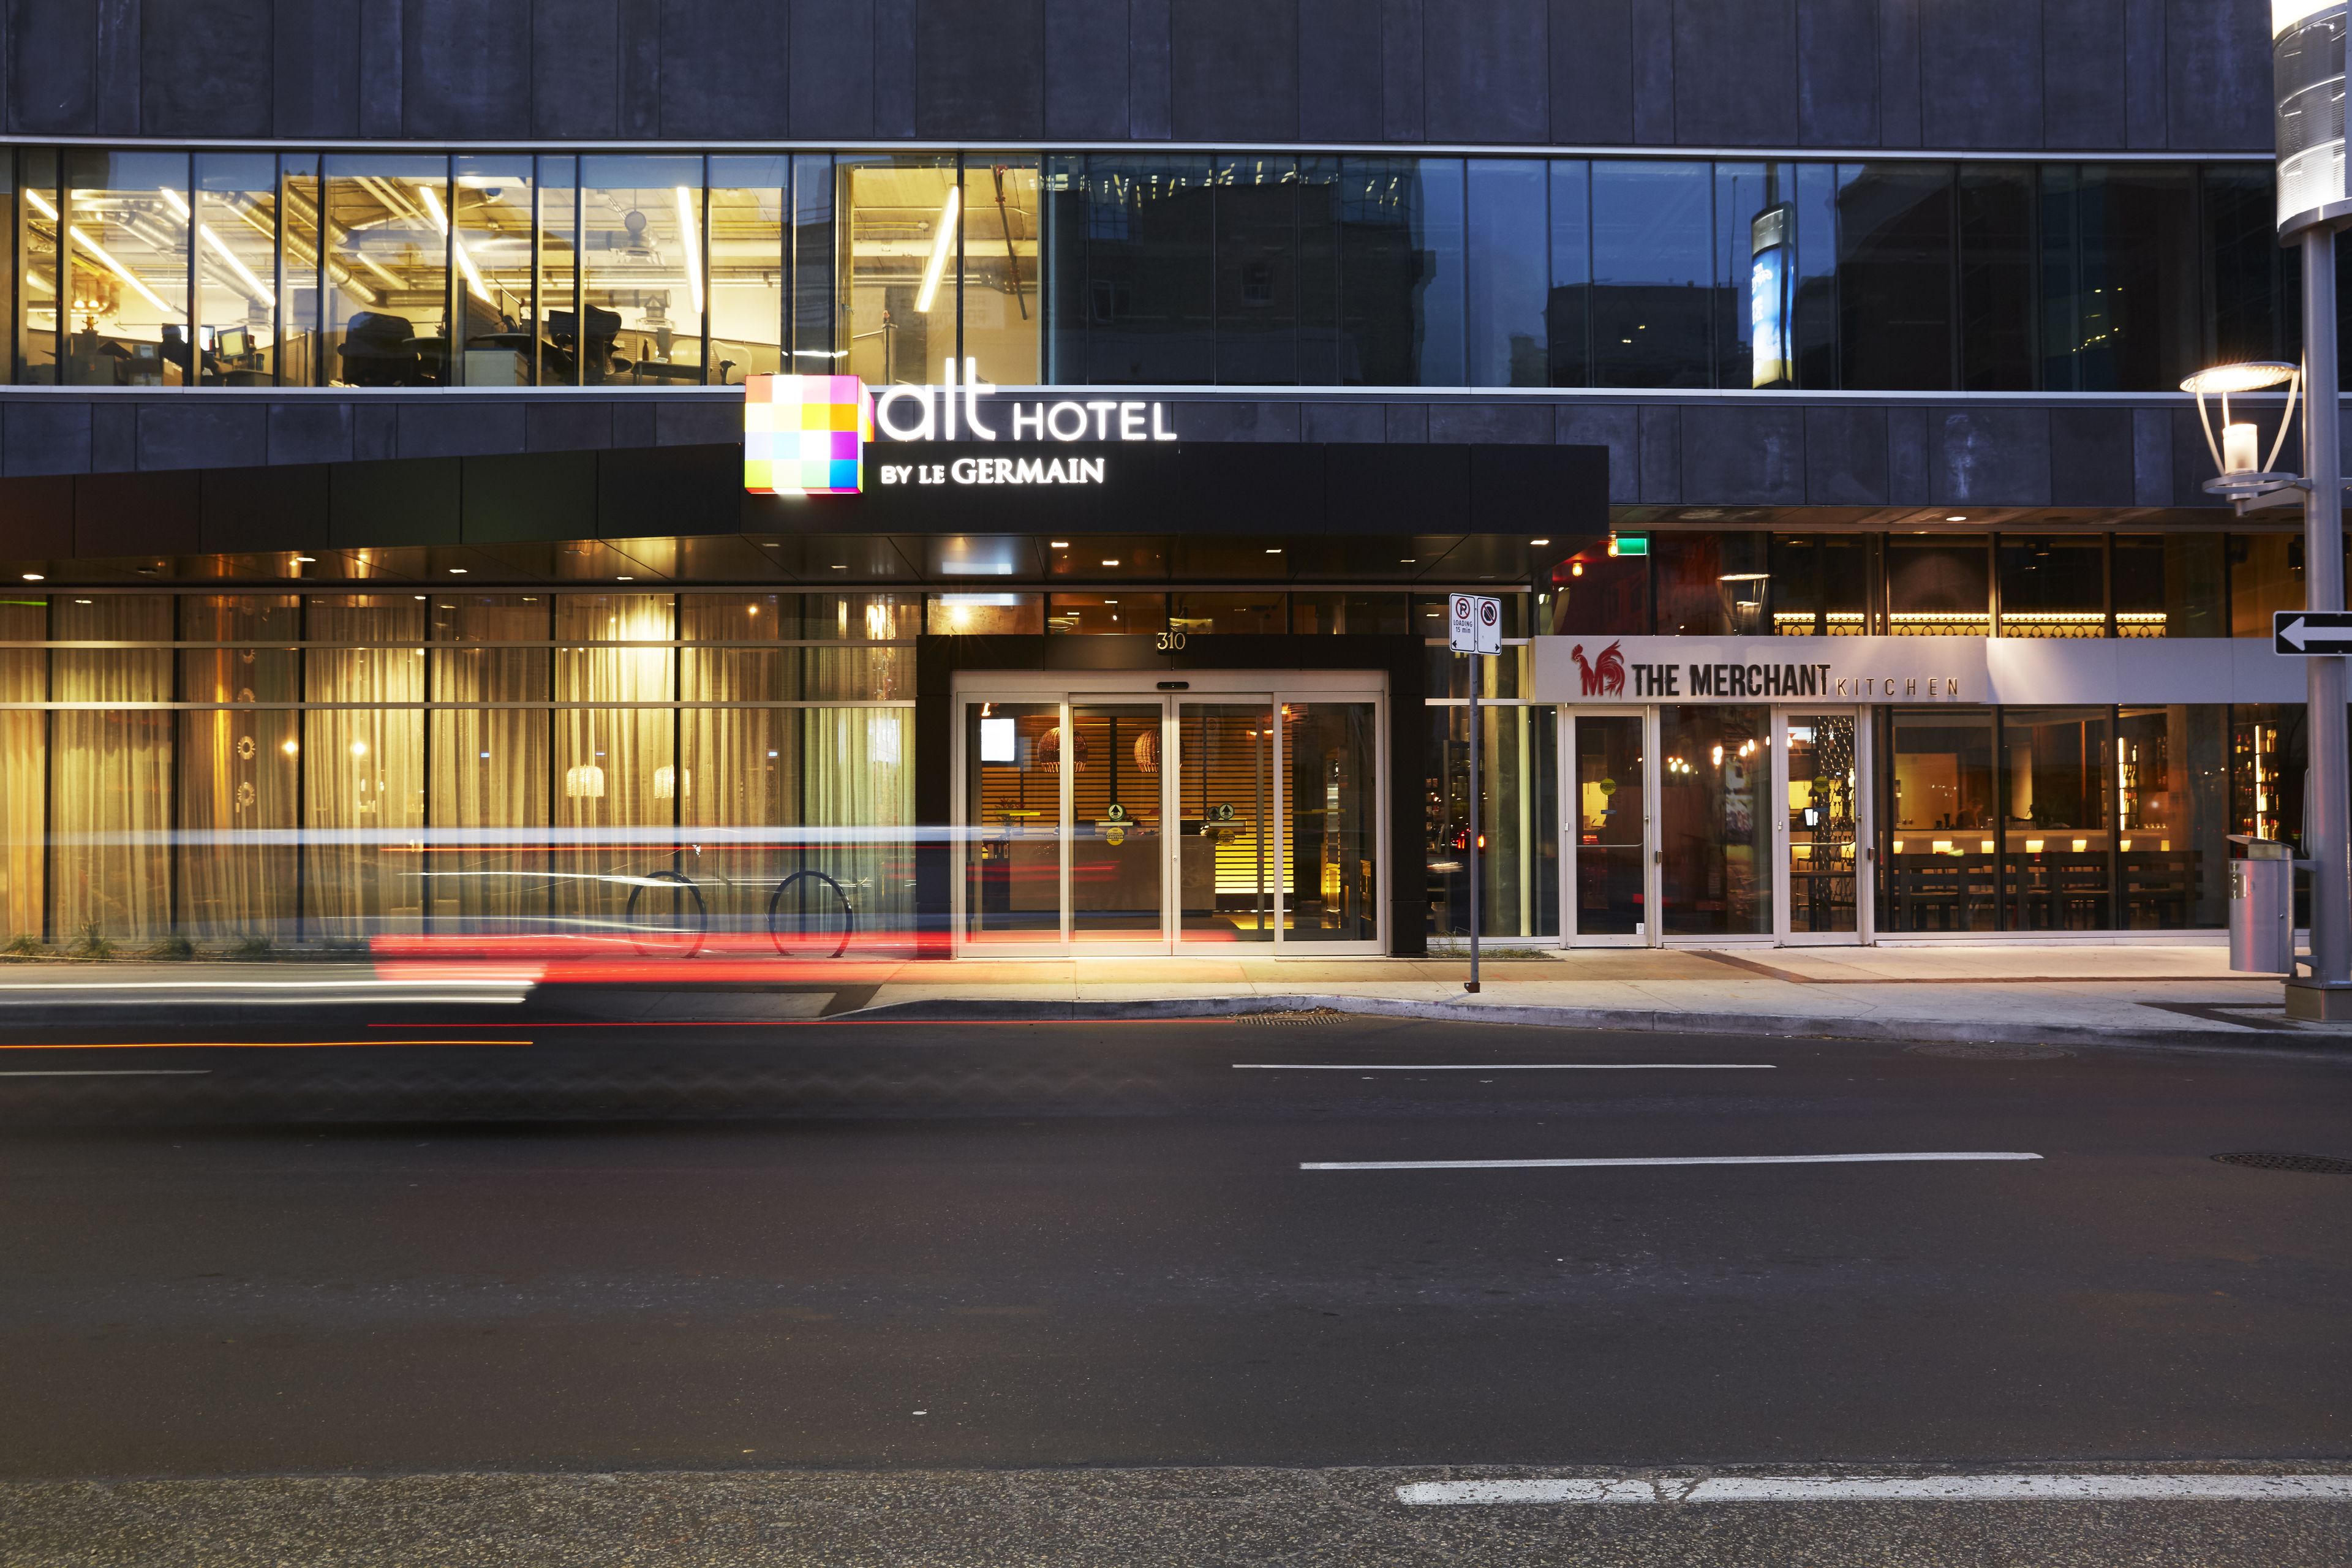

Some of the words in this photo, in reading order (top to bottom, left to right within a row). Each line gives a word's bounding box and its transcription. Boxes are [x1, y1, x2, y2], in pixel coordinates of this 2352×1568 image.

[877, 357, 996, 441] alt
[1014, 401, 1177, 441] HOTEL
[881, 466, 913, 484] BY
[918, 466, 945, 484] LE
[951, 458, 1105, 484] GERMAIN
[1157, 632, 1186, 649] 310
[1631, 664, 1680, 696] THE
[1690, 664, 1831, 696] MERCHANT
[1838, 679, 1958, 696] KITCHEN
